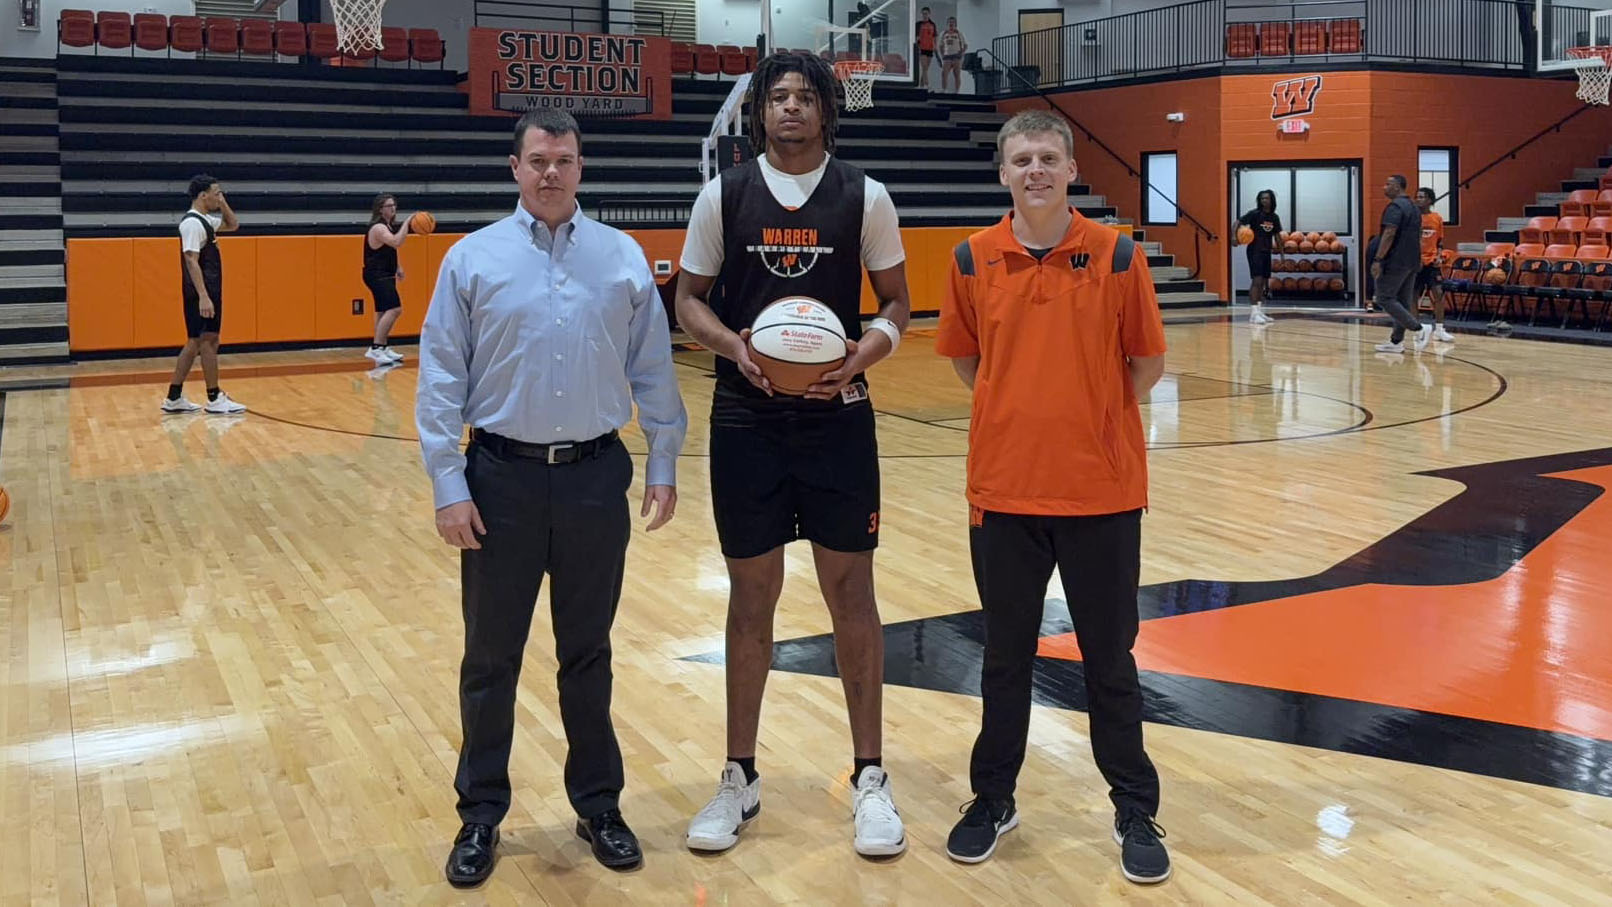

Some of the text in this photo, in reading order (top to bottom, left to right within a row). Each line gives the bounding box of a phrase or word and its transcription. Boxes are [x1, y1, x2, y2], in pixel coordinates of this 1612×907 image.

[498, 31, 647, 65] STUDENT
[506, 62, 641, 94] SECTION
[526, 95, 623, 110] WOOD YARD
[1271, 75, 1322, 120] W
[762, 228, 818, 246] WARREN
[1069, 252, 1090, 271] W
